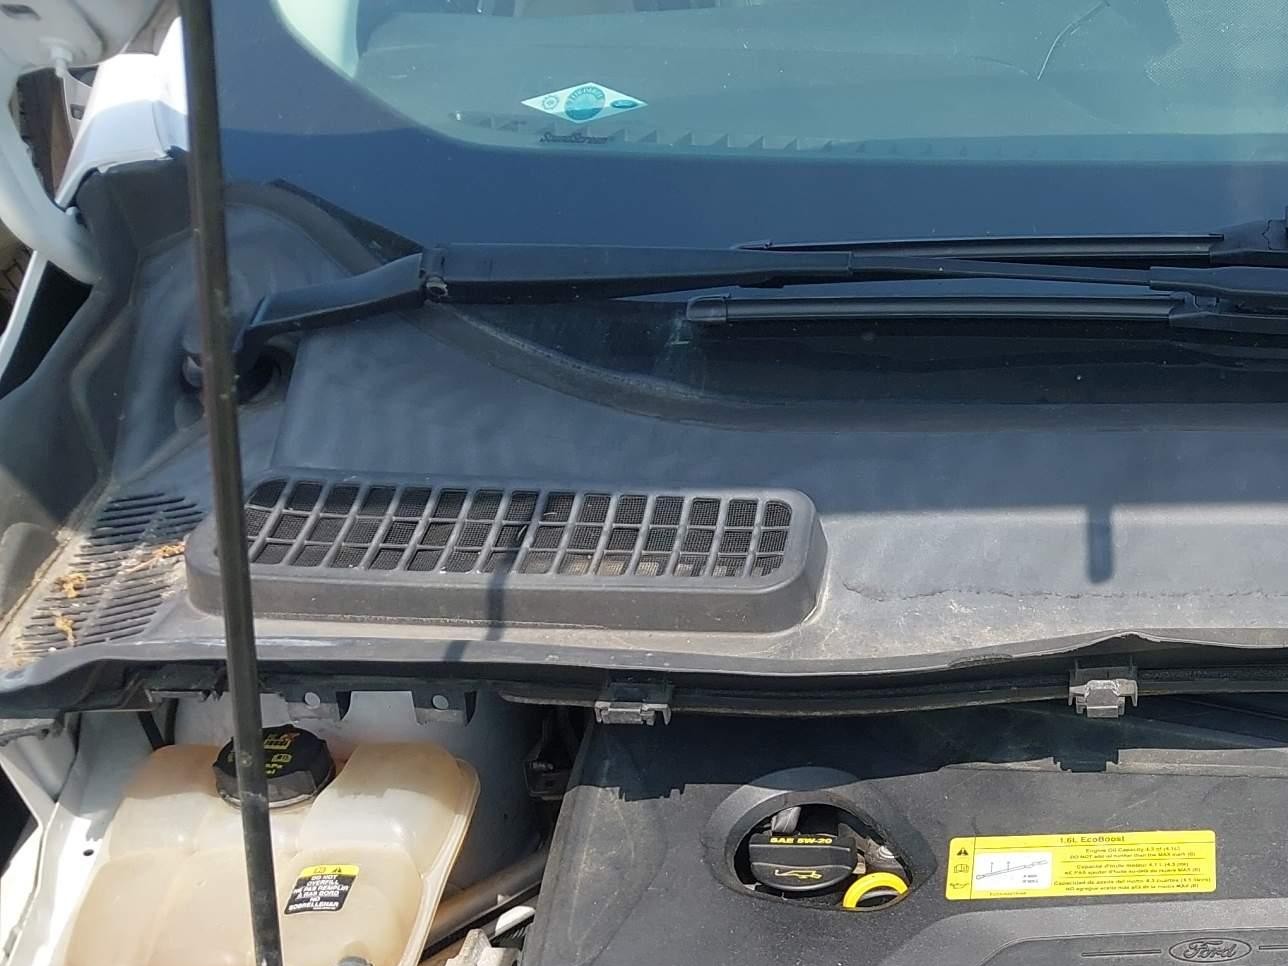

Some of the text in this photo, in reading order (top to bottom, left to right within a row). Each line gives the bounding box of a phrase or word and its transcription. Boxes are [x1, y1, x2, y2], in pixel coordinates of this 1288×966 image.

[797, 837, 833, 845] 5W-20
[1080, 835, 1125, 843] EcoBoost
[1183, 940, 1237, 958] Ford
